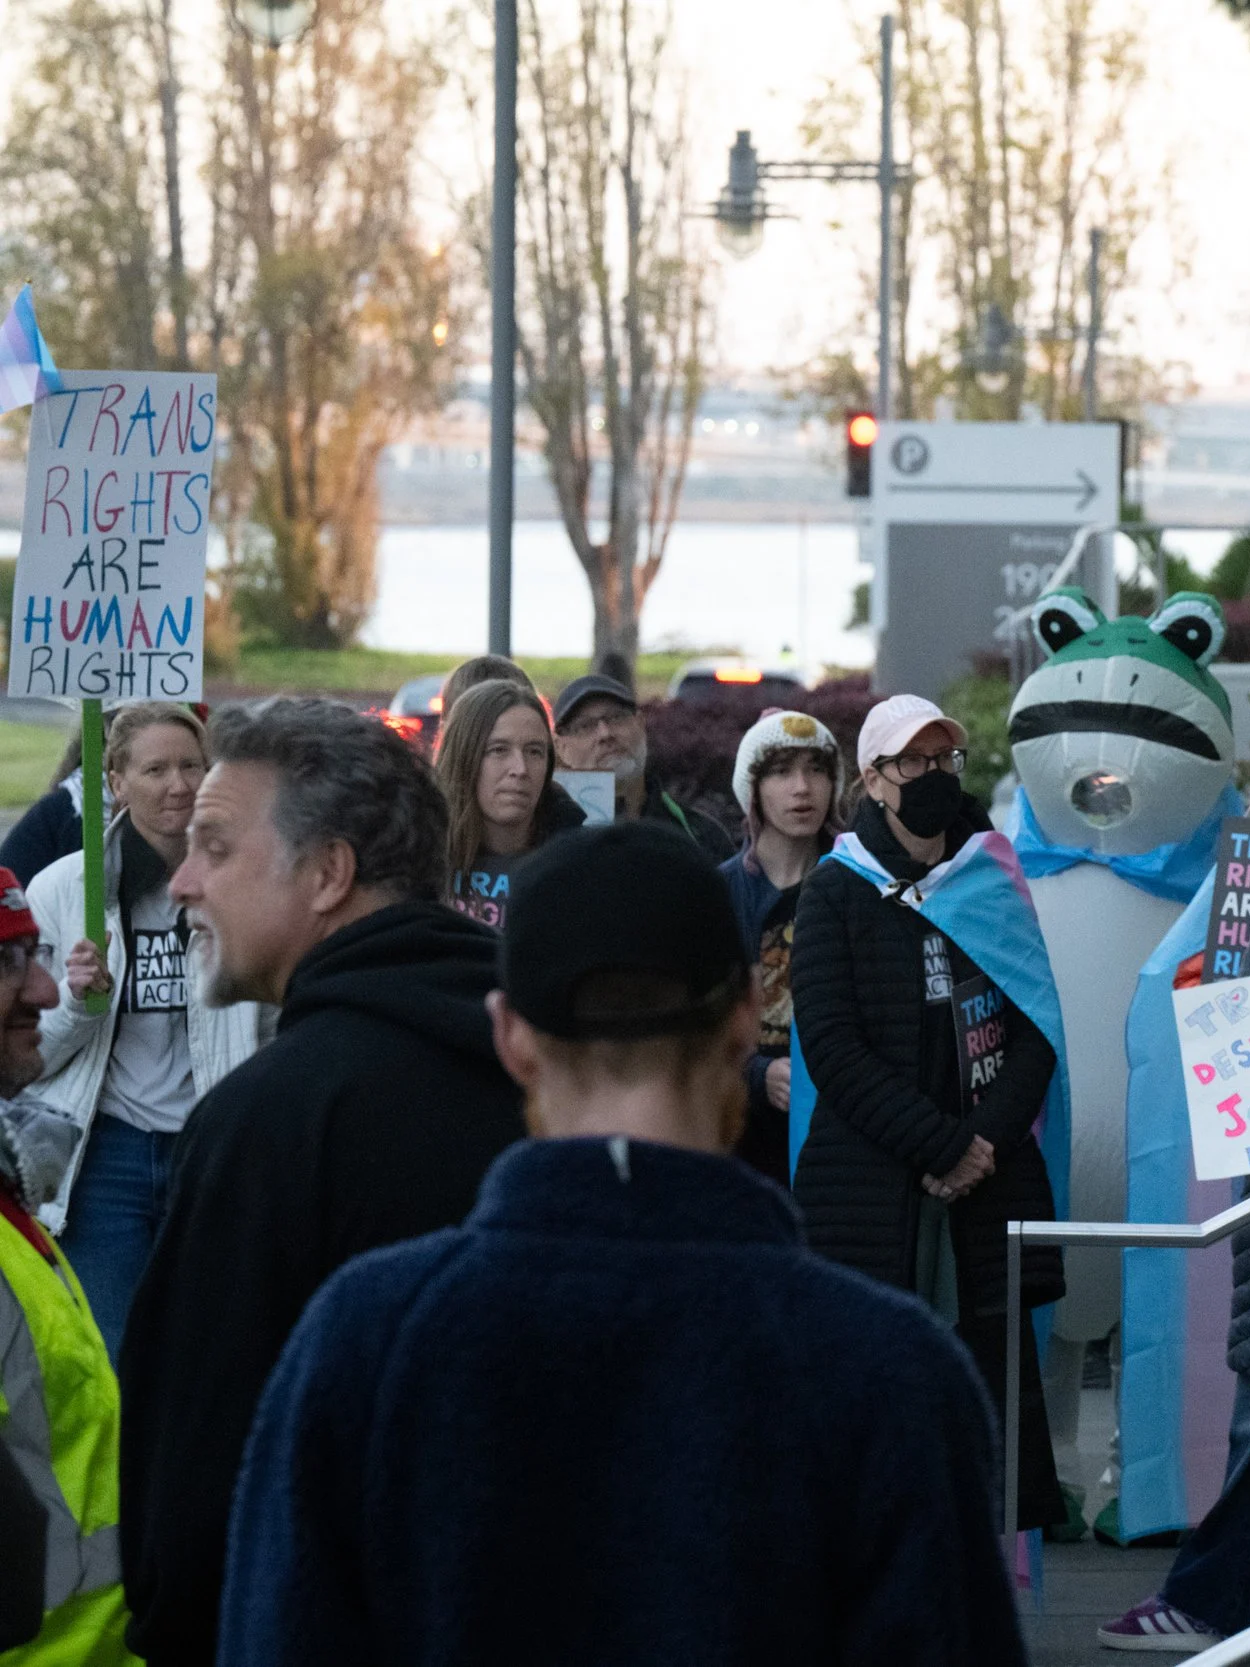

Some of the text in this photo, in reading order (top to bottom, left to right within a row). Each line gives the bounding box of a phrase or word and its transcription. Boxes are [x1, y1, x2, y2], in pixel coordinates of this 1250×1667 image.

[52, 383, 214, 457] TRANS
[42, 465, 209, 537] RIGHTS
[63, 538, 166, 594] ARE
[24, 594, 193, 650] HUMAN
[27, 646, 194, 697] RIGHTS
